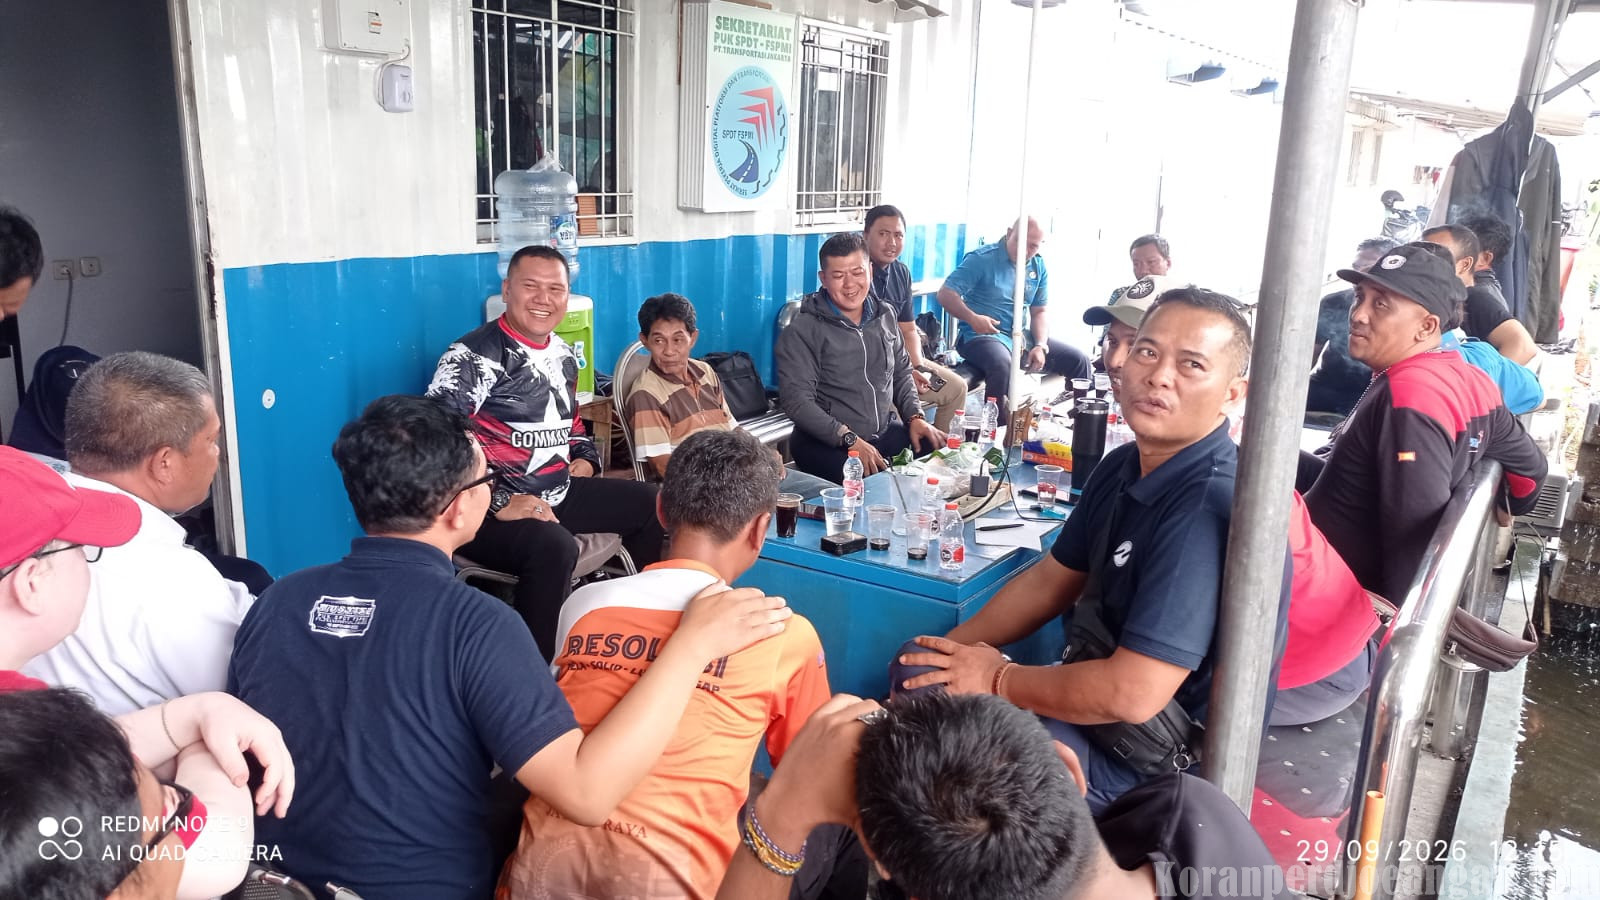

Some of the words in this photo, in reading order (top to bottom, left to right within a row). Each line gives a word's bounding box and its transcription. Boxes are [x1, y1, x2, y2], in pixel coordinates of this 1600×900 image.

[715, 16, 792, 40] SEKRETARIAT
[714, 32, 733, 46] PUK
[735, 35, 759, 48] SPDT
[765, 40, 792, 54] FSPMI
[767, 52, 791, 62] JAKARTA
[713, 87, 729, 126] PLATFORM
[728, 76, 738, 89] DAN
[722, 130, 736, 140] SPDT
[738, 131, 754, 140] FSPMI
[603, 818, 648, 838] RAYA
